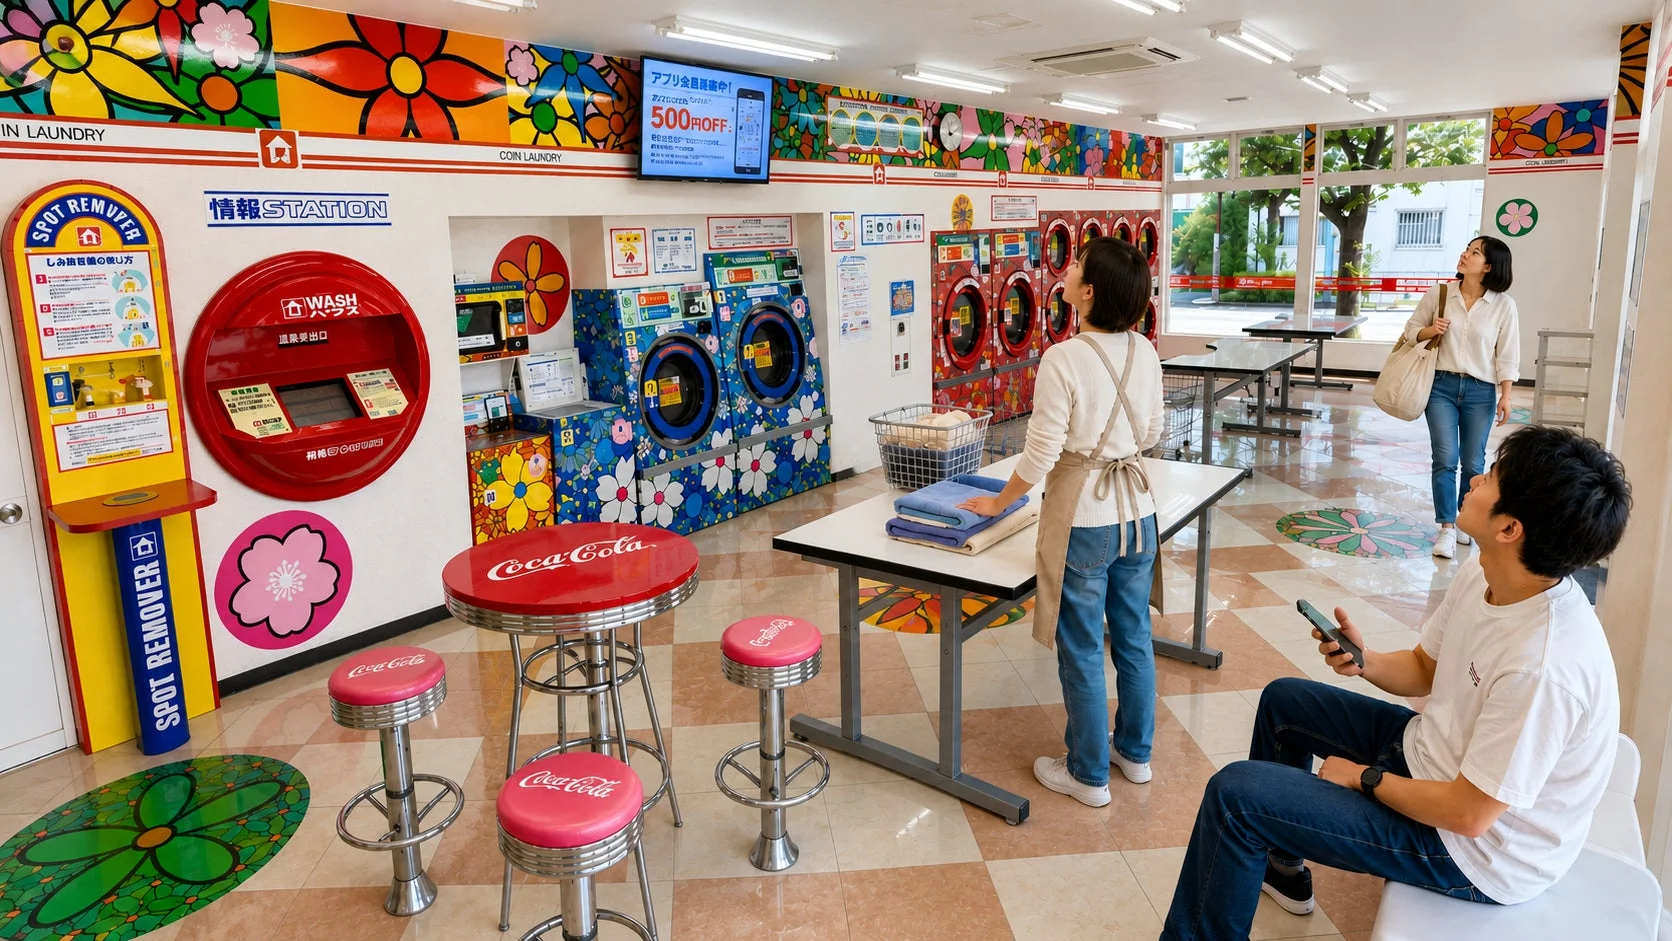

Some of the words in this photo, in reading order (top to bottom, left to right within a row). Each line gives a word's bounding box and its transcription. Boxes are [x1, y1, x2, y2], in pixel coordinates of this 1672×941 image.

[27, 125, 105, 141] LAUNDRY
[499, 150, 521, 161] COIN
[523, 152, 562, 162] LAUNDRY
[32, 204, 65, 243] SPOT
[305, 293, 358, 310] WASH
[487, 535, 657, 581] Coca-Cola
[133, 559, 172, 670] REMOVER
[149, 672, 181, 731] SPOT
